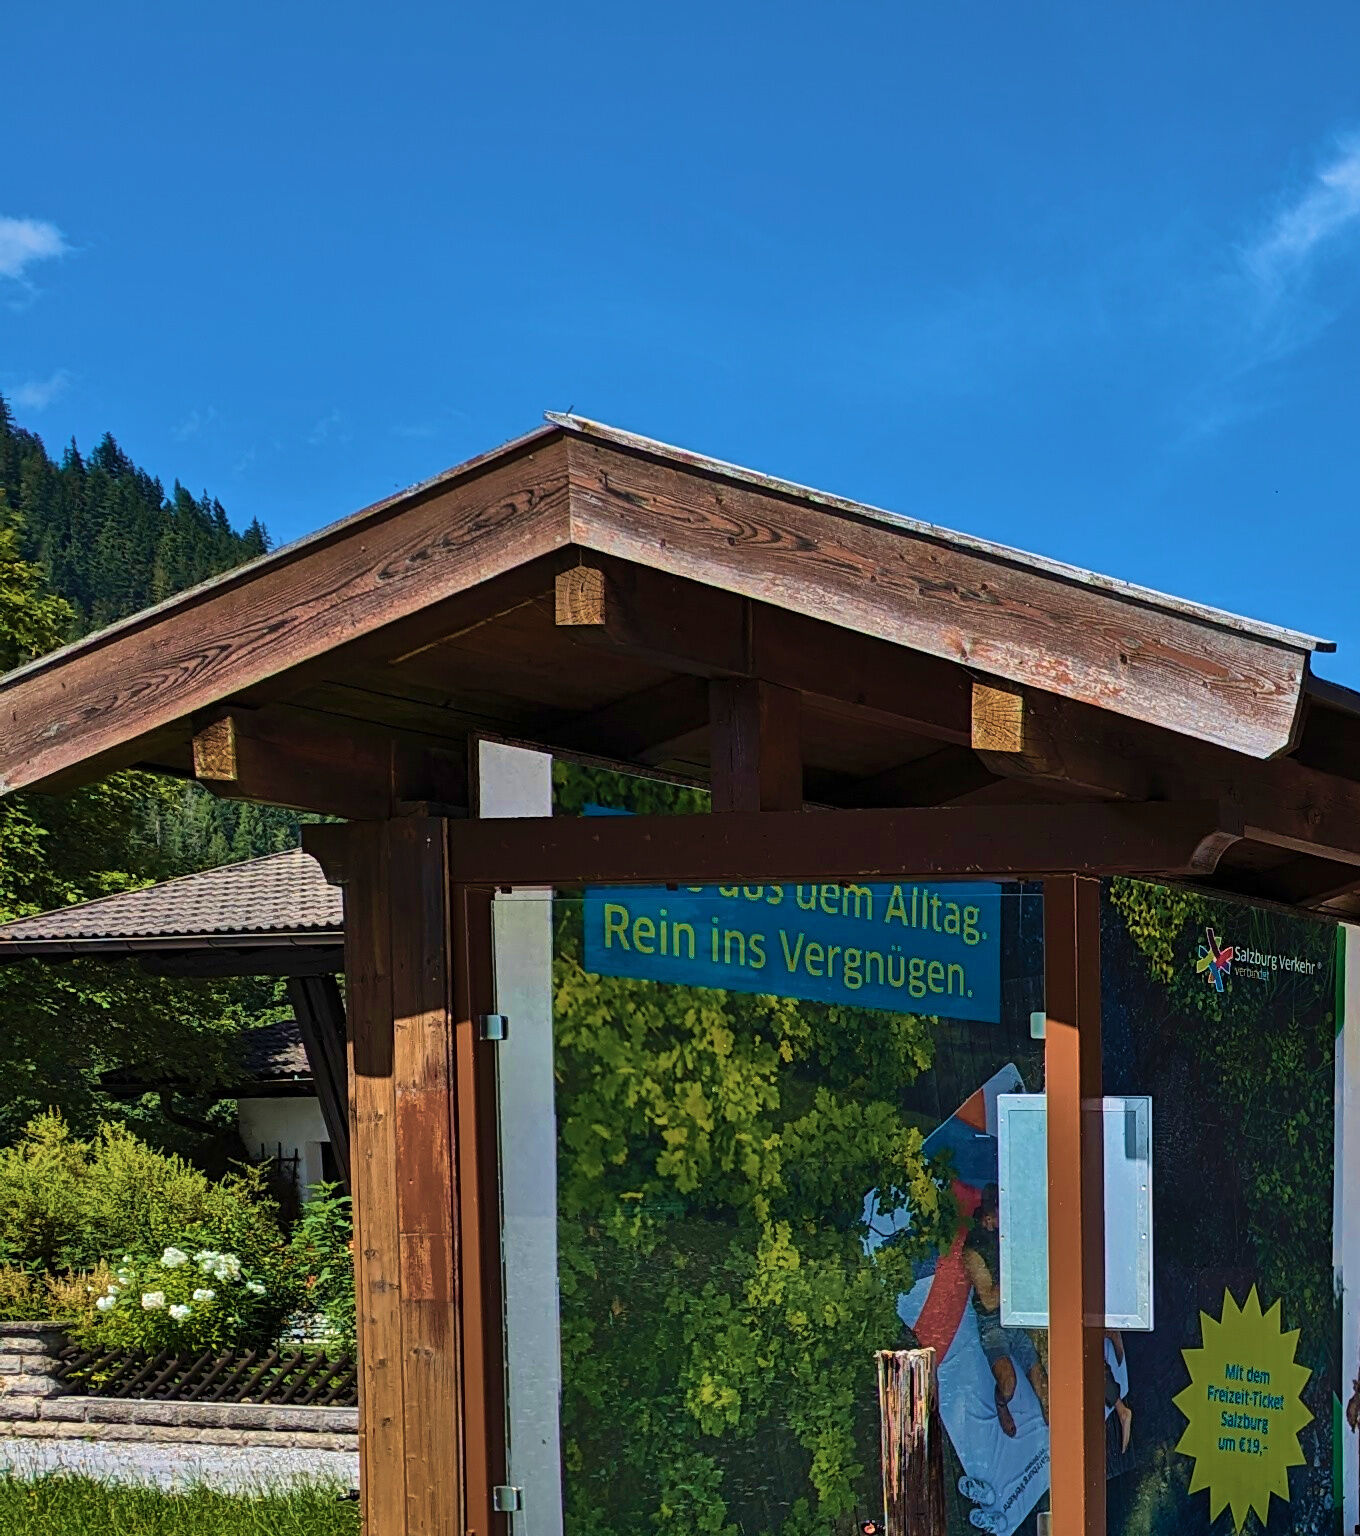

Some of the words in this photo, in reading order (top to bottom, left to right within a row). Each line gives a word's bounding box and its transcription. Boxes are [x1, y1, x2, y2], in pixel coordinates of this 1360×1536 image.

[884, 885, 988, 946] Alltag.
[604, 903, 696, 960] Rein
[710, 916, 766, 969] ins
[779, 929, 973, 998] Vergnügen.
[1235, 946, 1277, 970] Salzburg
[1279, 954, 1315, 976] Verkehr
[1235, 966, 1270, 981] verbindet
[1225, 1363, 1244, 1380] Mit
[1246, 1366, 1270, 1385] dem
[1207, 1385, 1284, 1410] Freizeit-Ticket
[1221, 1411, 1269, 1435] Salzburg
[1218, 1437, 1236, 1451] um
